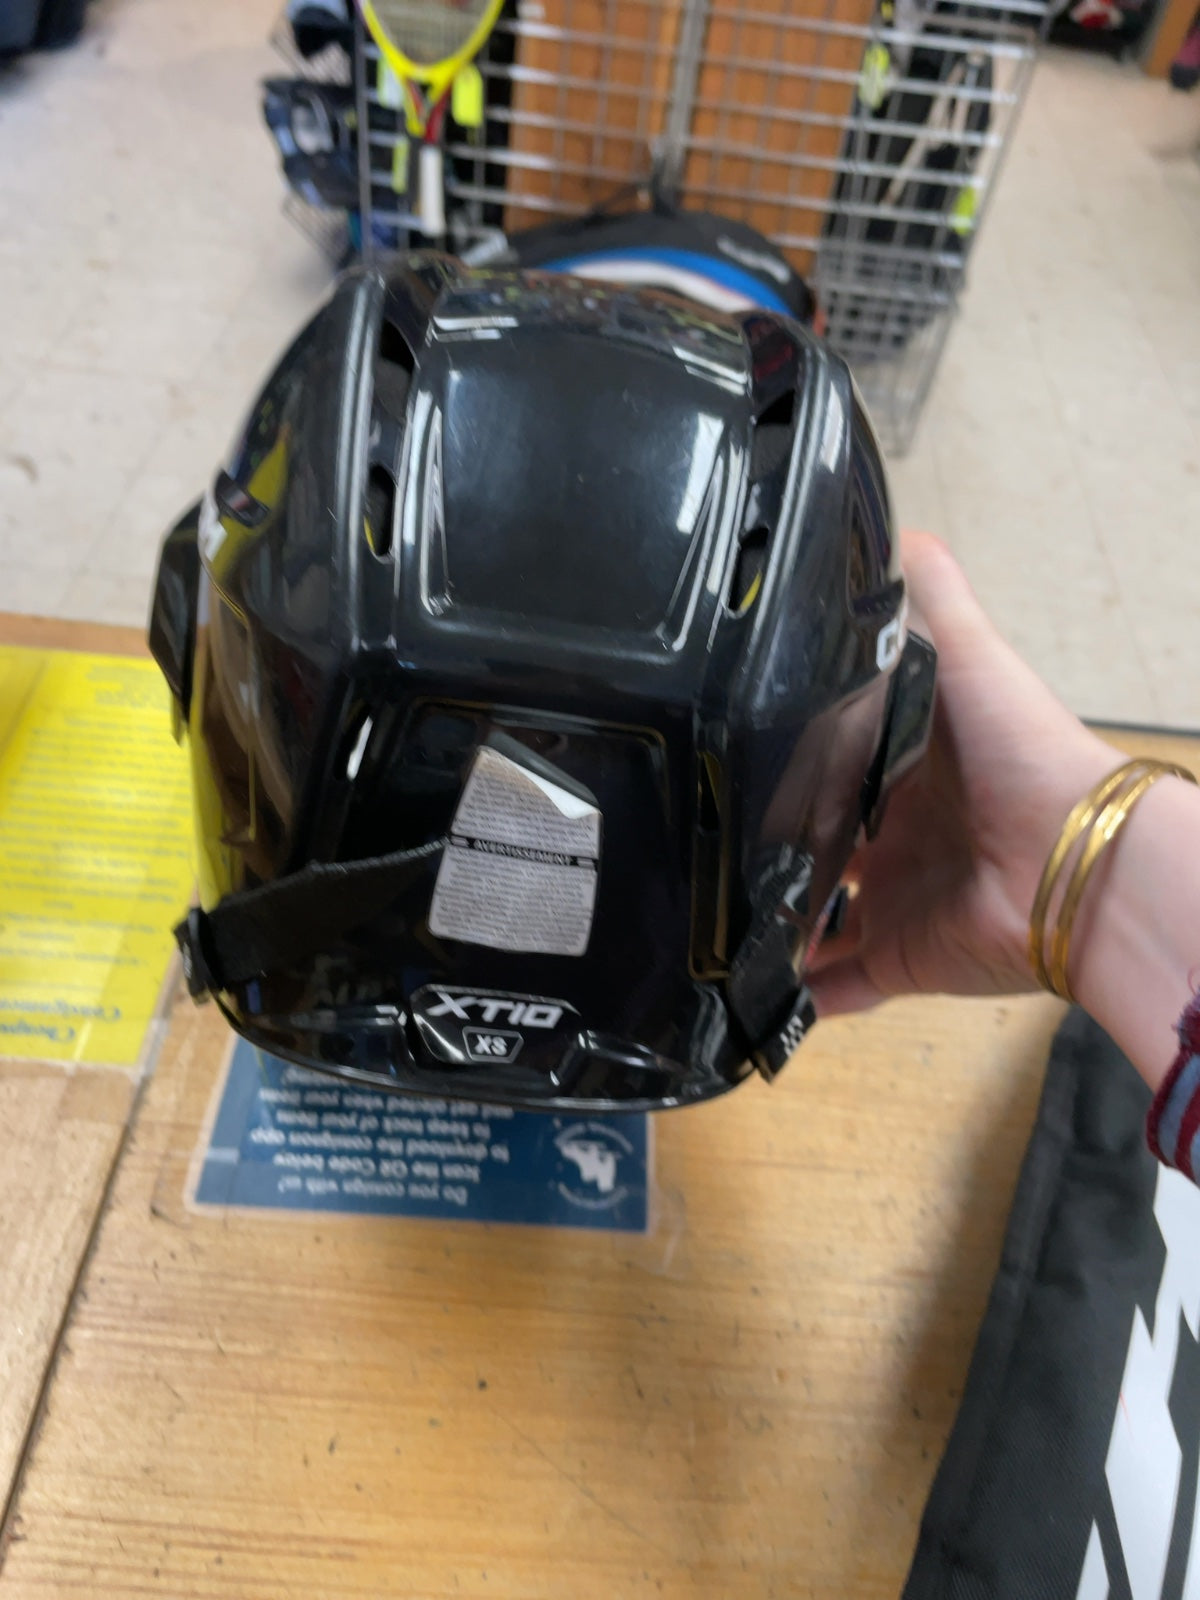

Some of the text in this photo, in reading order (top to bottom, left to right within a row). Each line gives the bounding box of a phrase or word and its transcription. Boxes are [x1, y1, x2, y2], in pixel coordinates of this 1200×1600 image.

[426, 991, 564, 1029] XT10
[473, 1033, 508, 1056] XS
[304, 1089, 340, 1106] your
[276, 1109, 491, 1140] to keep track of your items
[250, 1126, 286, 1146] app
[376, 1136, 404, 1157] the
[405, 1138, 488, 1162] download
[491, 1144, 510, 1164] to
[273, 1152, 325, 1172] below
[328, 1155, 377, 1176] Code
[379, 1158, 408, 1179] QR
[411, 1161, 439, 1181] the
[305, 1176, 339, 1196] with
[343, 1177, 405, 1199] consign
[409, 1183, 440, 1201] you
[443, 1185, 468, 1206] Do
